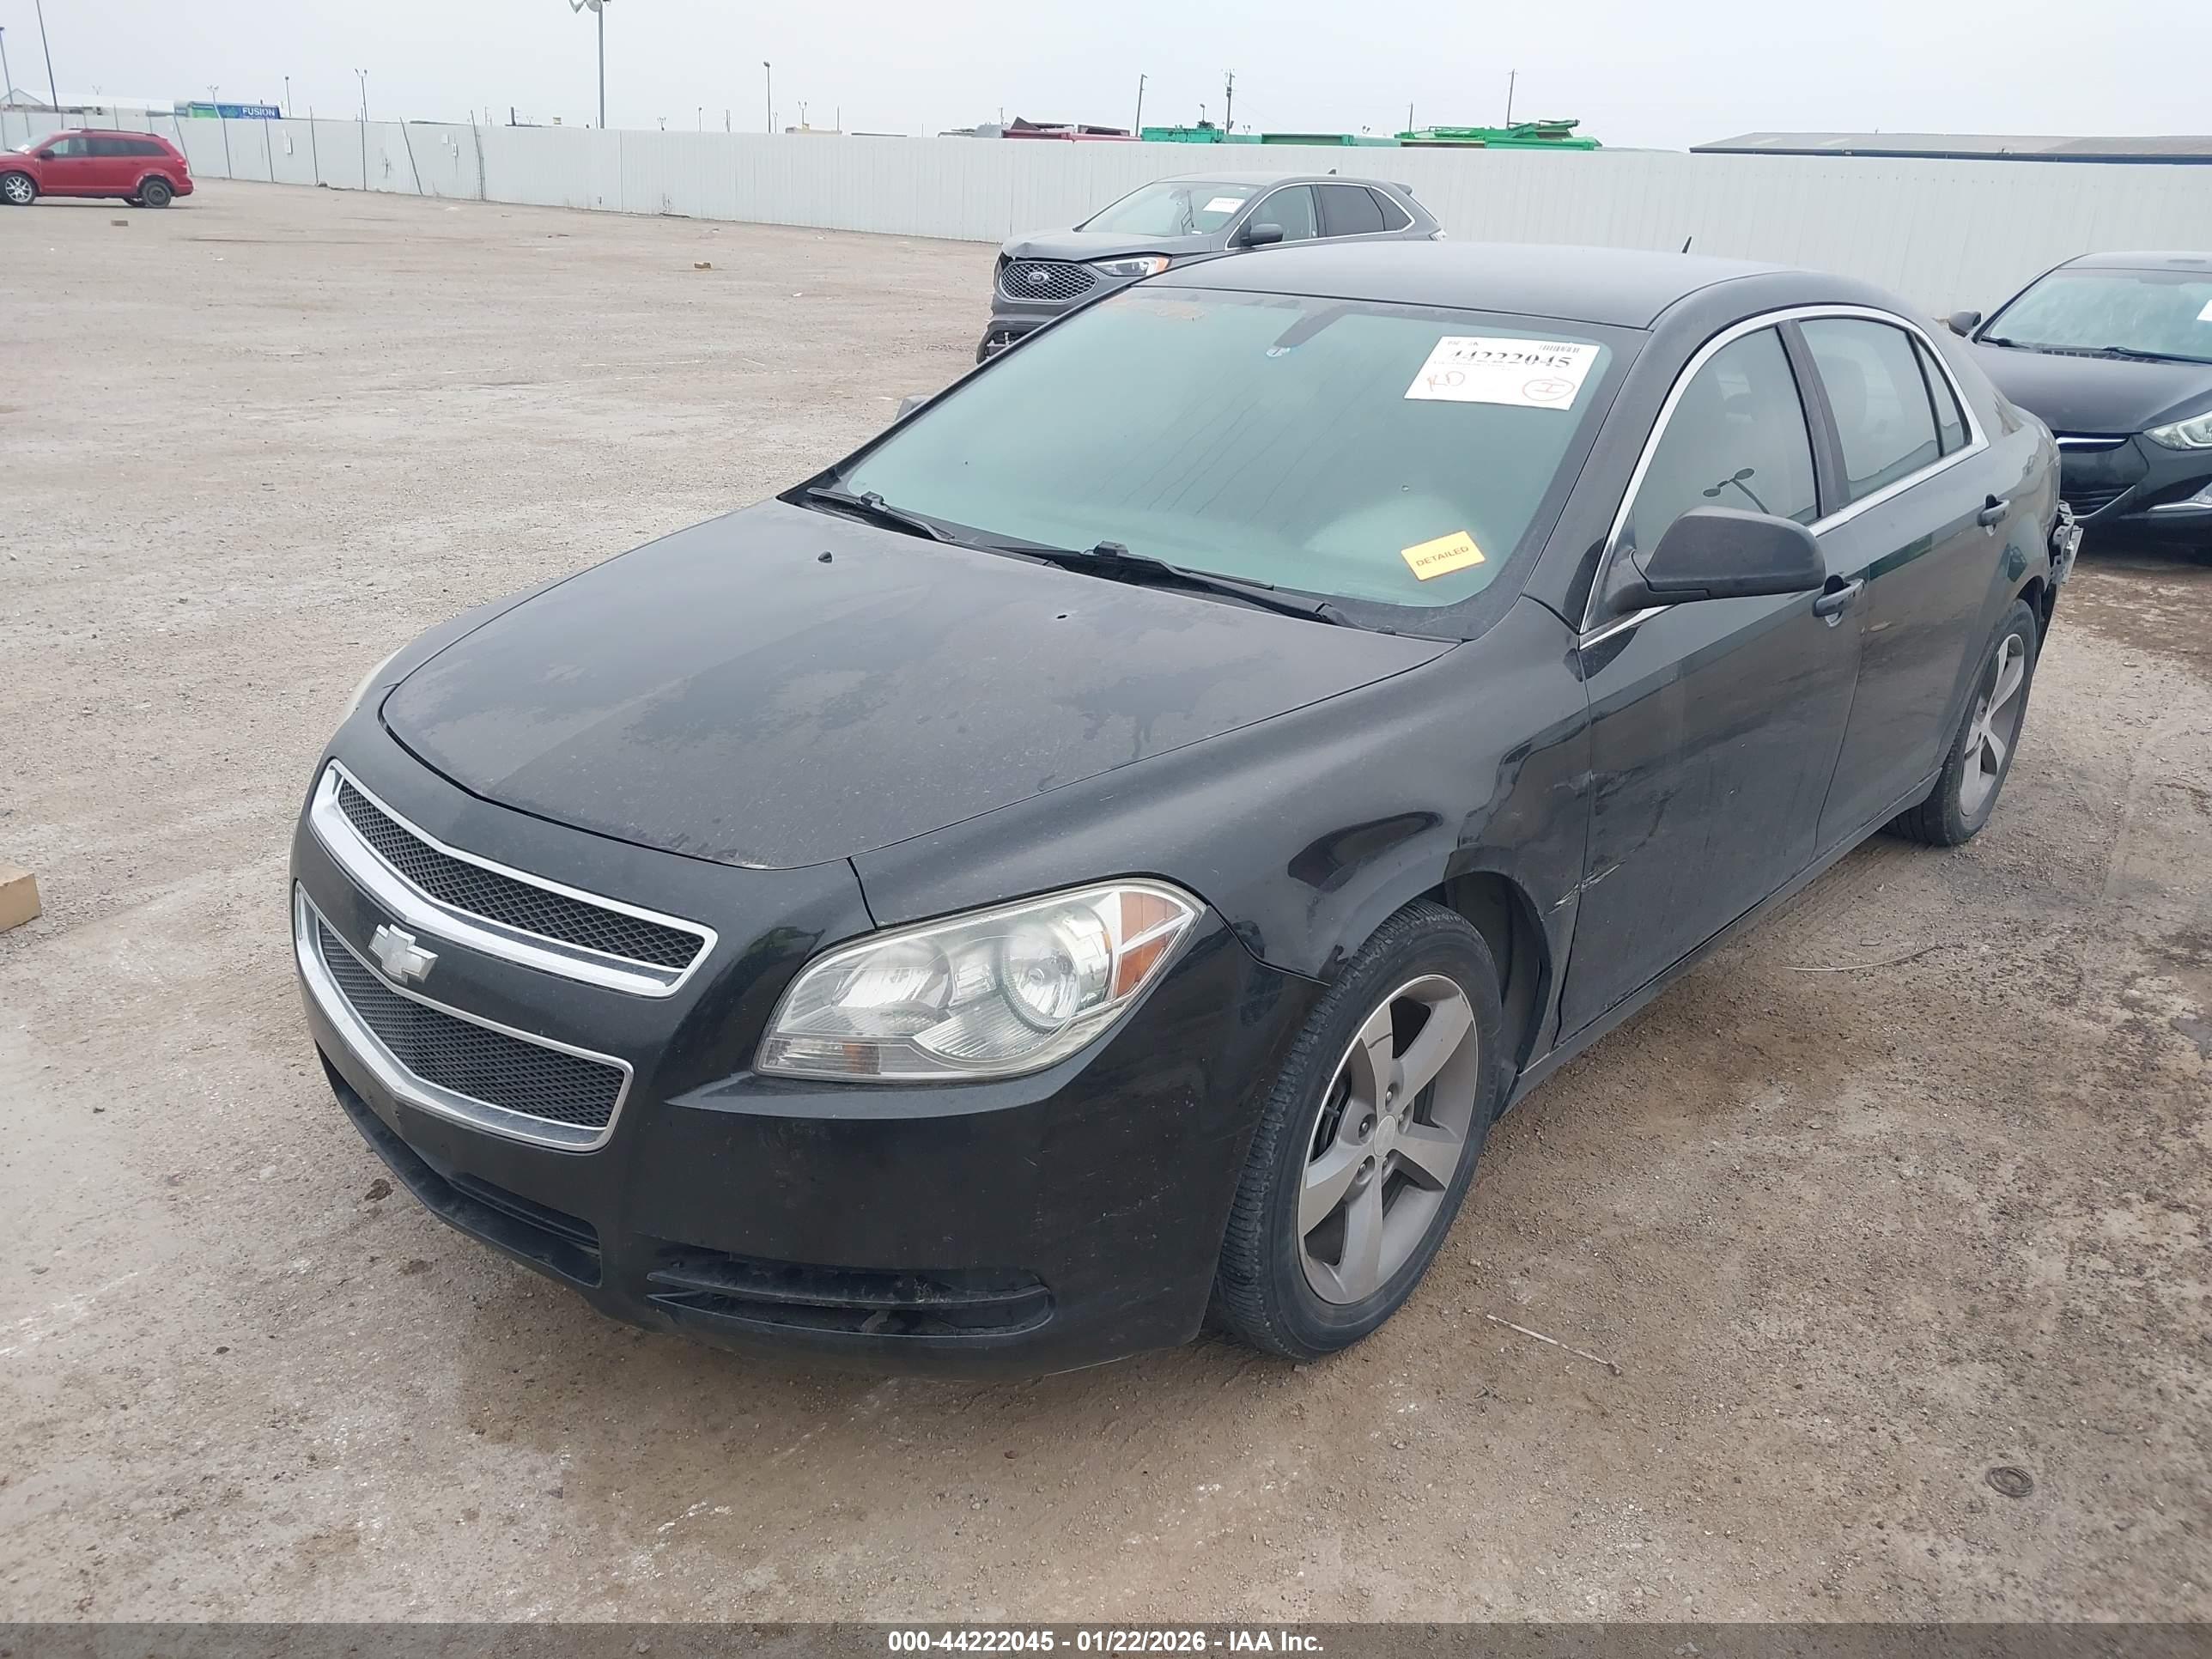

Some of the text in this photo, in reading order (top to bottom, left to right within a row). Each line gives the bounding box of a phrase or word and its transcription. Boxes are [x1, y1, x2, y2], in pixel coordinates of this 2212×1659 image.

[242, 107, 276, 117] FUSION
[1449, 349, 1573, 368] 44222045
[1416, 545, 1469, 567] DETAILED
